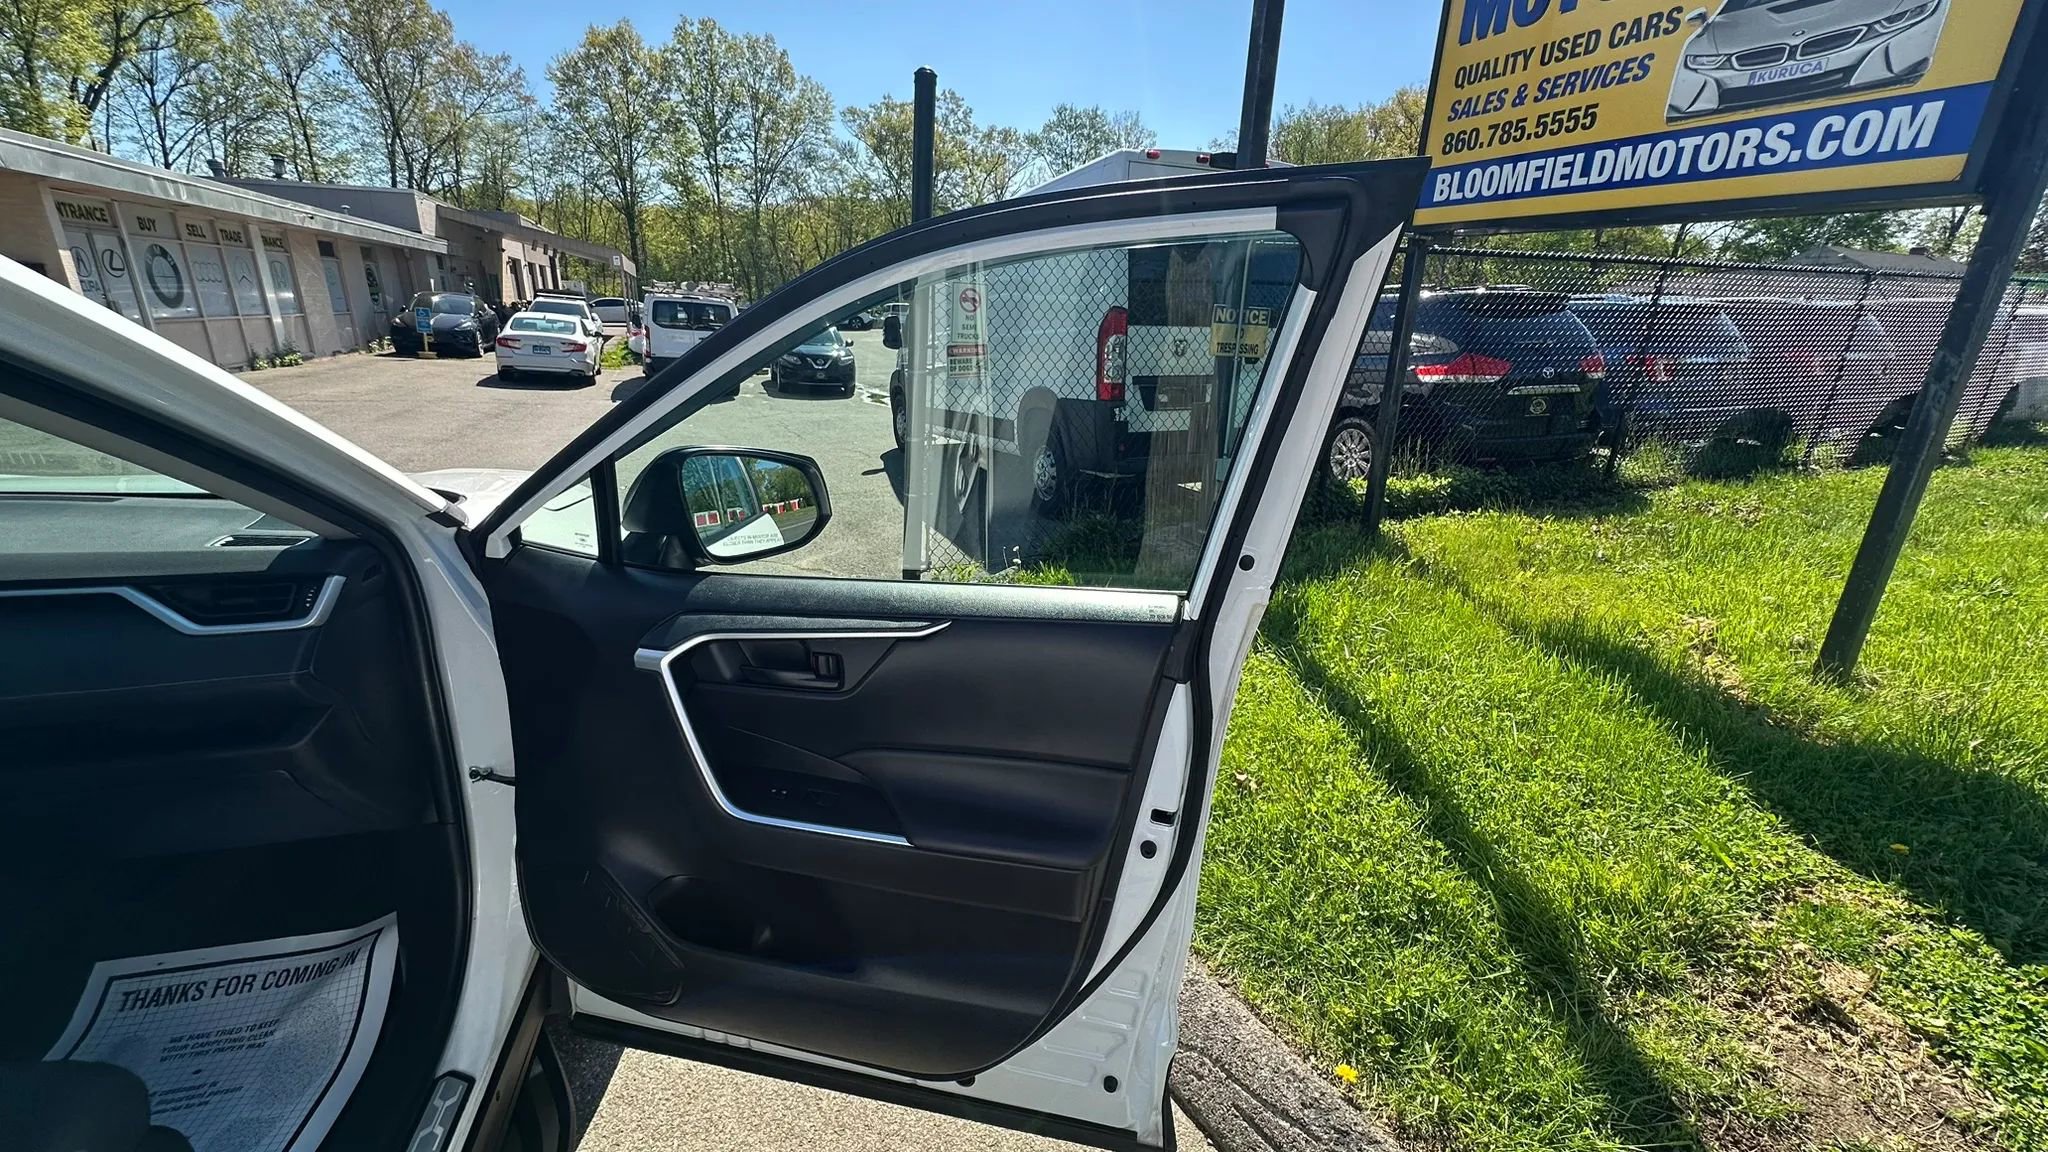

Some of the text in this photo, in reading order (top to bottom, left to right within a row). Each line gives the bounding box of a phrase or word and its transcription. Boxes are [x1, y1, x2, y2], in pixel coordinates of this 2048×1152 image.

[1454, 6, 1684, 90] QUALITY USED CARS
[1756, 61, 1824, 83] KURUCA
[1447, 53, 1655, 122] SALES & SERVICES
[1442, 103, 1599, 156] 860.785.5555
[1433, 100, 1946, 202] BLOOMFIELDMOTORS.COM
[55, 201, 108, 223] NTRANCE
[136, 216, 157, 232] BUY
[185, 223, 207, 239] SELL
[219, 229, 244, 243] TRADE
[1217, 342, 1259, 355] TRESPSSING
[118, 948, 362, 1013] THANKS FOR COMING IN
[215, 1026, 243, 1037] TRIED
[245, 1023, 257, 1033] TO
[258, 1018, 280, 1030] KEEP
[247, 1028, 276, 1042] CLEAN
